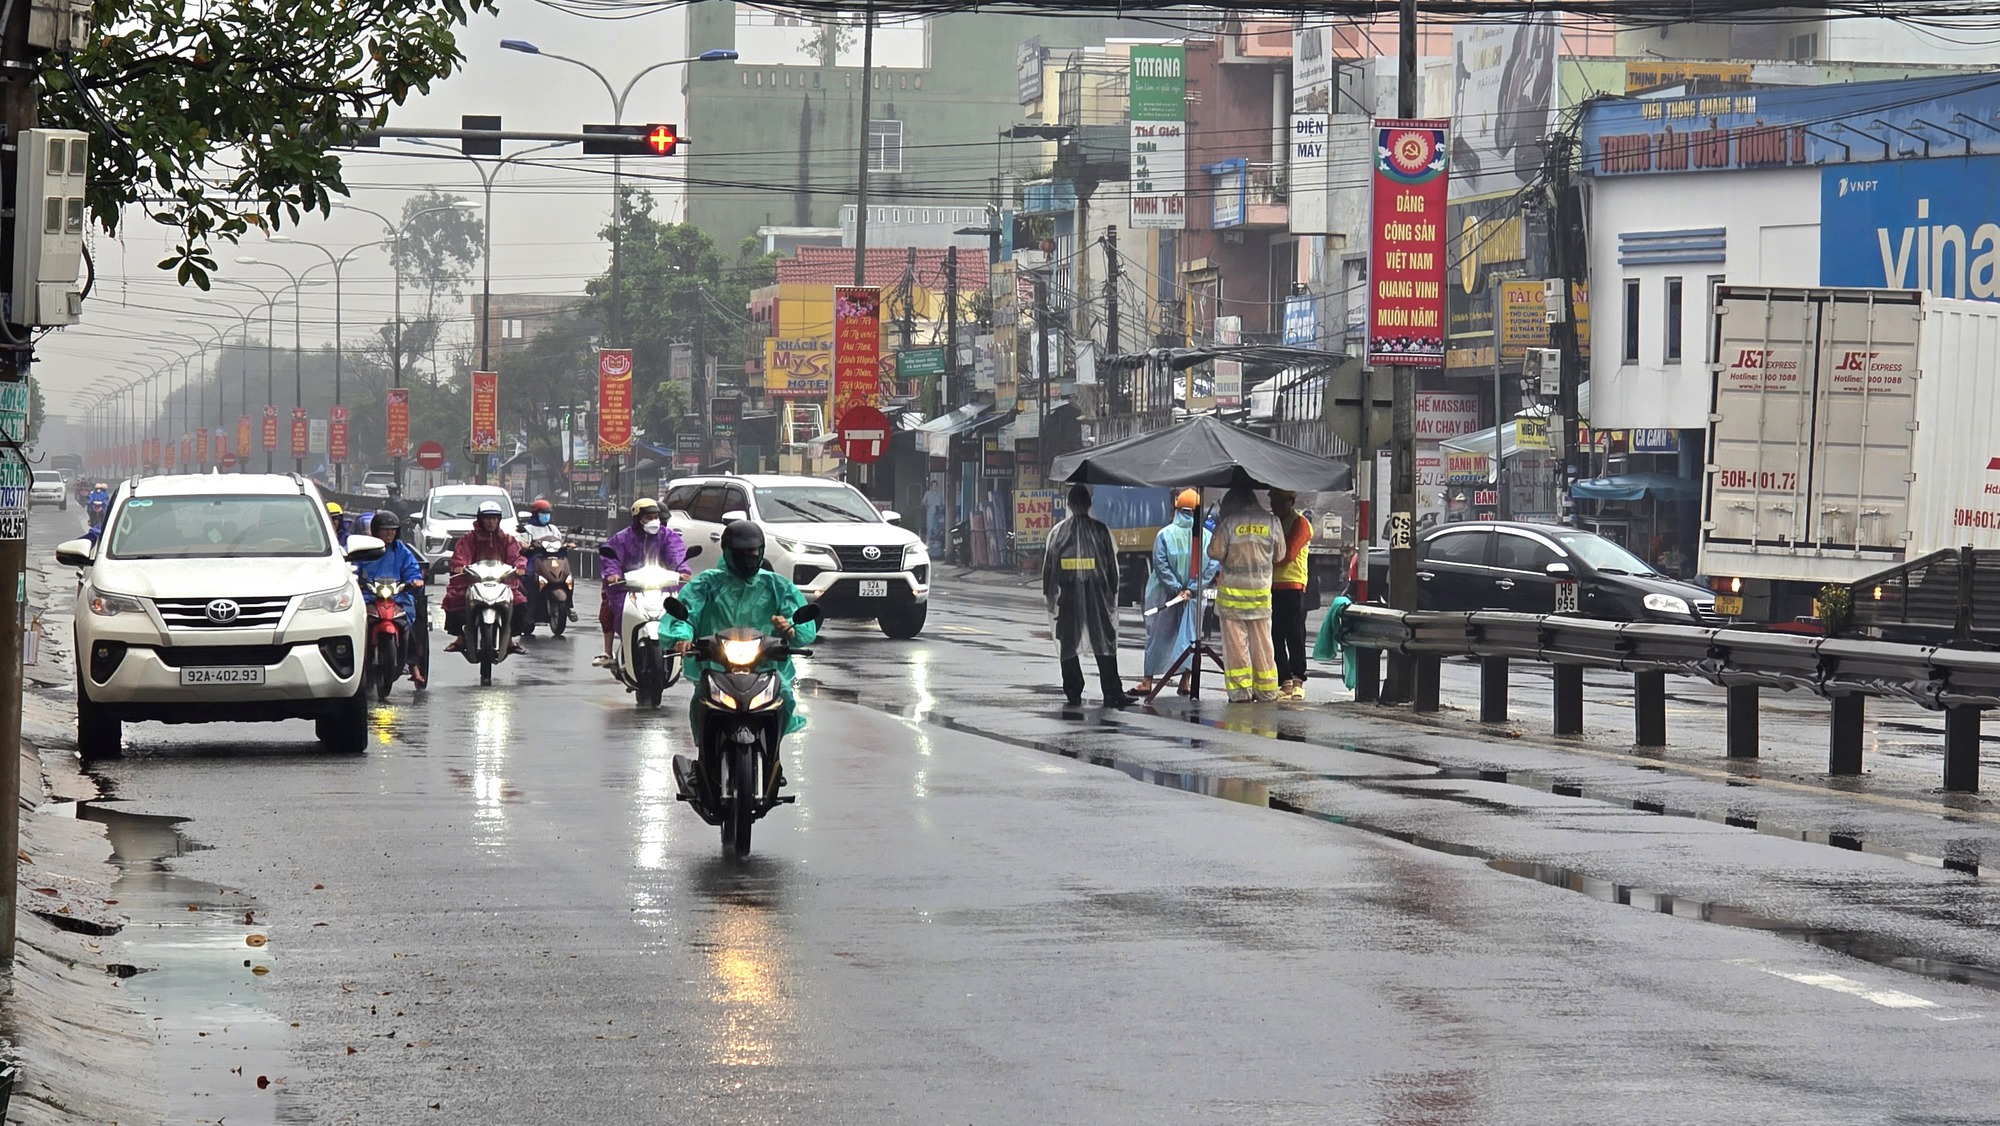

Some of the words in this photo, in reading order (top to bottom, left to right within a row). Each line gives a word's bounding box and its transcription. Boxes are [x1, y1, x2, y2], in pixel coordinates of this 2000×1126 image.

[1134, 57, 1181, 77] TATANA
[1735, 96, 1757, 114] NAM
[1135, 124, 1155, 137] Thế
[1159, 125, 1180, 137] Giới
[1296, 117, 1324, 137] ĐIỆN
[1297, 140, 1322, 158] MÁY
[1599, 133, 1651, 173] TRUNG
[1850, 180, 1879, 192] VNPT
[1133, 196, 1158, 215] MINH
[1162, 193, 1184, 215] TIẾN
[1396, 190, 1425, 213] ĐẢNG
[1384, 220, 1412, 244] CỘNG
[1414, 219, 1436, 242] SẢN
[1386, 249, 1407, 273] VIỆT
[1409, 252, 1433, 270] NAM
[1379, 280, 1413, 300] QUANG
[1415, 281, 1439, 299] VINH
[1508, 287, 1531, 303] TÀI
[1377, 306, 1408, 326] MUÔN
[1410, 306, 1438, 328] NĂM!
[776, 338, 818, 351] KHÁCH
[1730, 350, 1774, 369] J&T
[1766, 361, 1797, 370] EXPRESS
[1871, 363, 1903, 372] EXPRESS
[1730, 373, 1758, 381] Hotline:
[1778, 374, 1797, 382] 1088
[1834, 375, 1863, 383] Hotline:
[1884, 376, 1902, 384] 1088
[1432, 399, 1477, 413] MASSAGE
[1435, 420, 1461, 436] CHẠY
[1449, 456, 1472, 472] BÁNH
[1019, 490, 1029, 498] A.
[1031, 490, 1054, 498] MINH
[1024, 514, 1051, 529] MÌ
[1391, 515, 1411, 530] CS
[867, 581, 880, 589] 92A
[1560, 582, 1573, 596] H9
[1557, 597, 1575, 611] 955
[187, 670, 258, 682] 92A-402.93
